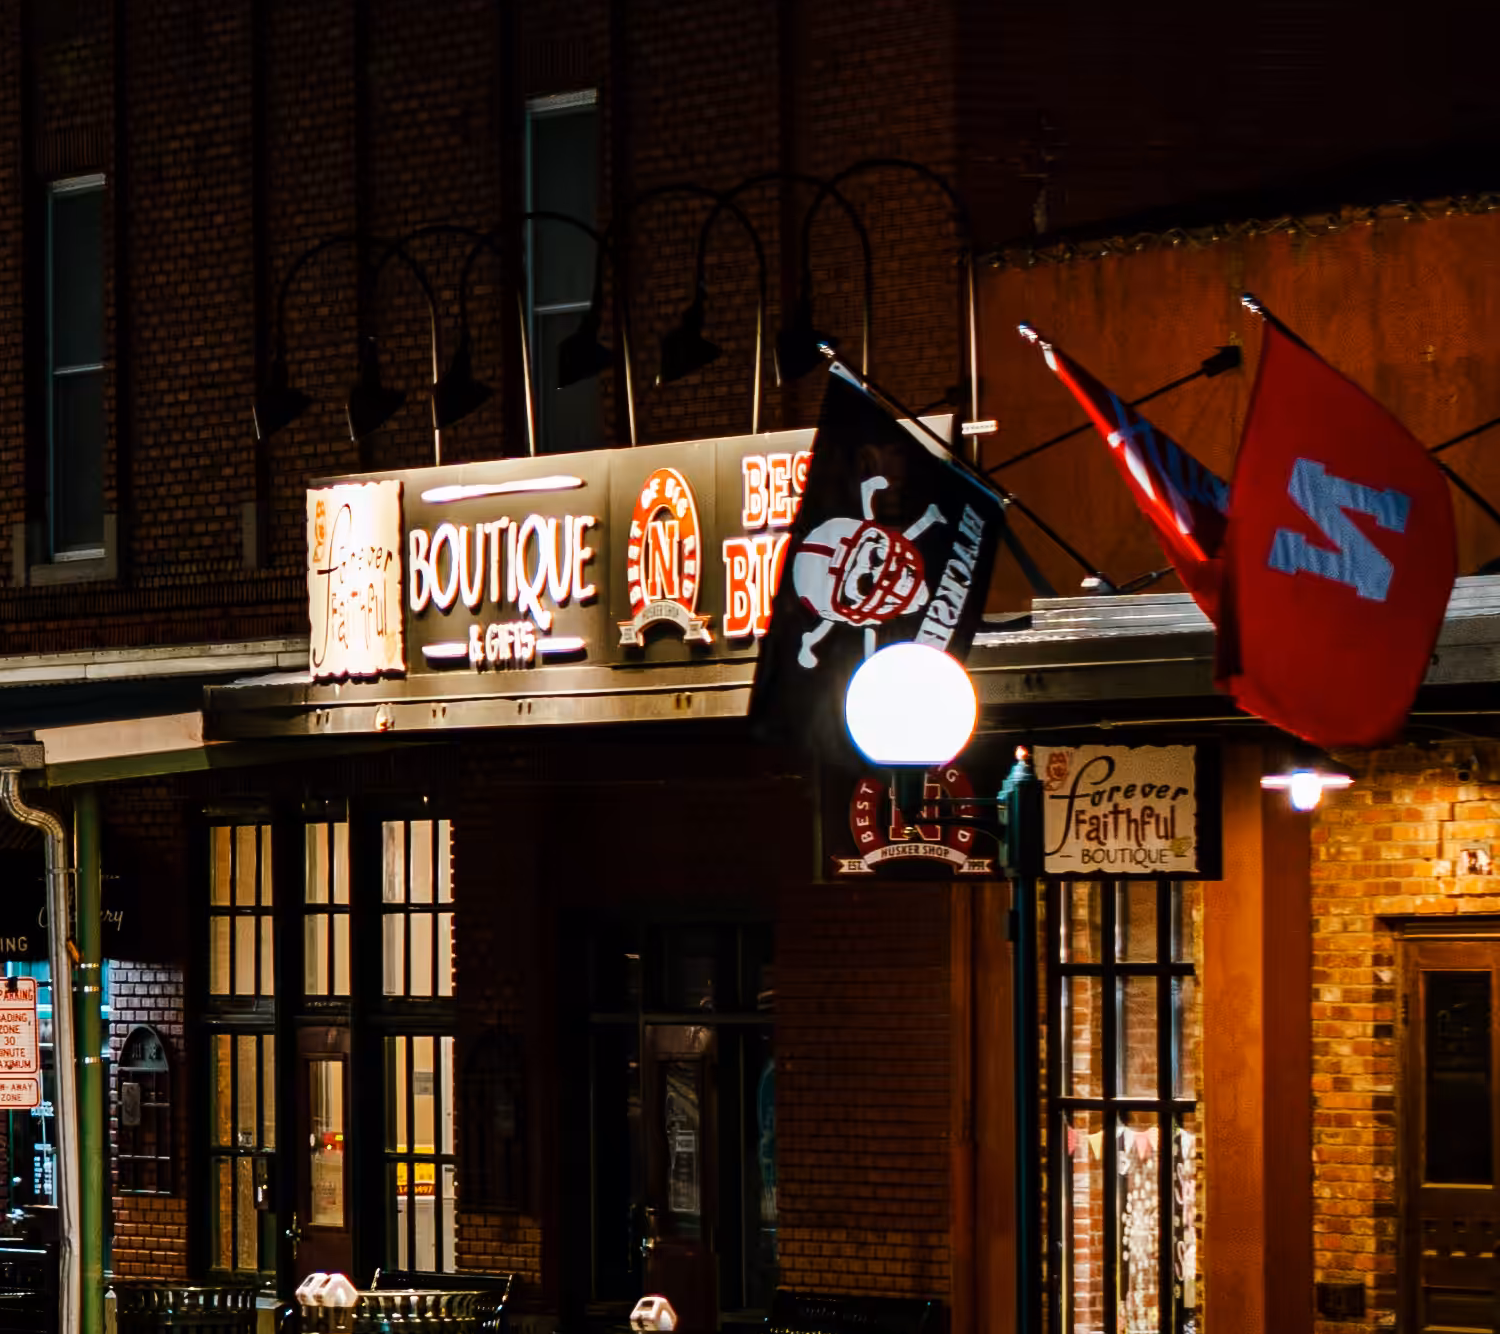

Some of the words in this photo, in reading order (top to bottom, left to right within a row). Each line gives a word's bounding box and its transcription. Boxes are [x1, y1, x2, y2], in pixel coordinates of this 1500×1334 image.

[743, 451, 813, 527] BES
[410, 513, 597, 631] BOUTIQUE
[856, 782, 875, 844] BEST
[1074, 803, 1176, 847] Faithful
[880, 844, 919, 858] HUSKER
[922, 845, 950, 857] SHOP
[1081, 848, 1169, 867] BOUTIQUE
[4, 1036, 16, 1046] 30
[1, 1094, 22, 1102] ZONE
